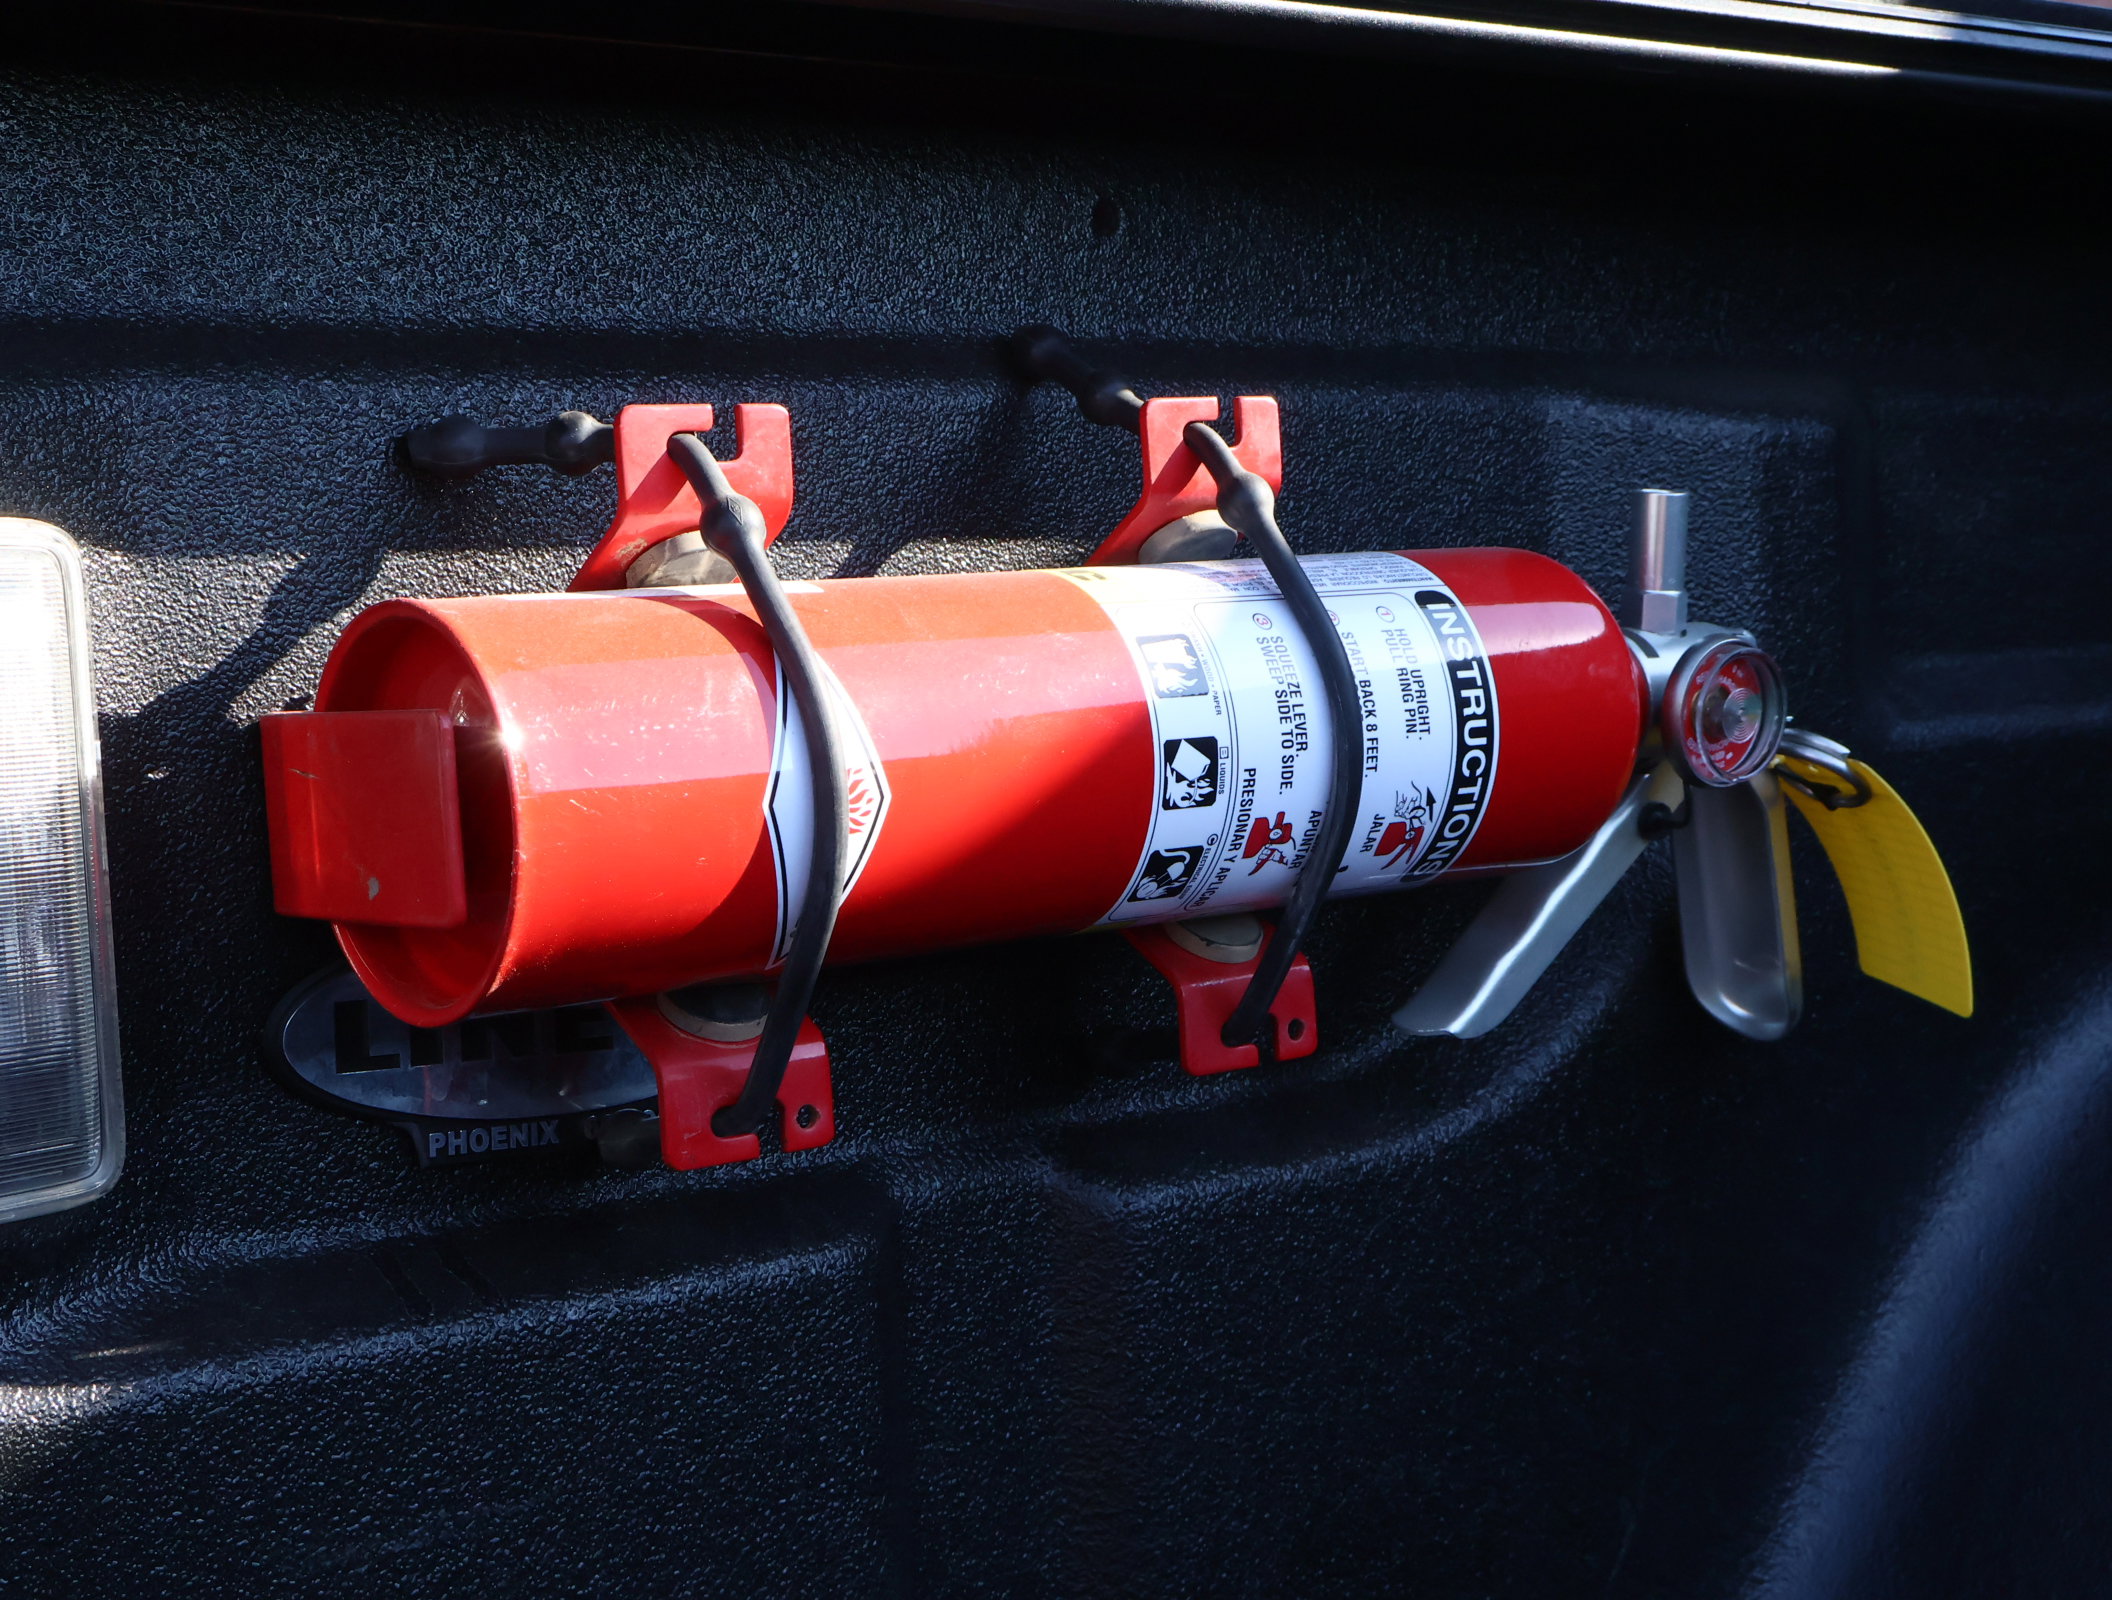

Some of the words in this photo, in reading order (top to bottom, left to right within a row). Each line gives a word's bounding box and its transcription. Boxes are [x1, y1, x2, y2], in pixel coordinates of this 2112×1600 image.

[1256, 636, 1284, 685] SWEEP
[1341, 631, 1369, 675] START
[1381, 629, 1403, 663] PULL
[1212, 690, 1222, 716] PAPER
[1270, 635, 1303, 699] SQUEEZE
[1291, 703, 1308, 757] LEVER.
[1358, 679, 1378, 719] BACK
[1394, 628, 1418, 664] HOLD
[1410, 669, 1431, 740] UPRIGHT.
[1396, 667, 1414, 703] RING
[1275, 689, 1293, 725] SIDE
[1404, 708, 1417, 739] PIN.
[1281, 729, 1295, 750] TO
[1365, 723, 1378, 733] 8
[1416, 603, 1487, 874] INSTRUCTIONS
[1279, 754, 1295, 795] SIDE.
[1364, 737, 1379, 778] FEET.
[1218, 762, 1226, 795] LIQUIDS
[1227, 767, 1257, 852] PRESIONAR
[1288, 810, 1322, 870] APUNTAR
[1360, 813, 1385, 853] JALAR
[1223, 853, 1235, 863] Y
[1191, 867, 1231, 907] APLICAR
[429, 1120, 559, 1159] PHOENIX
